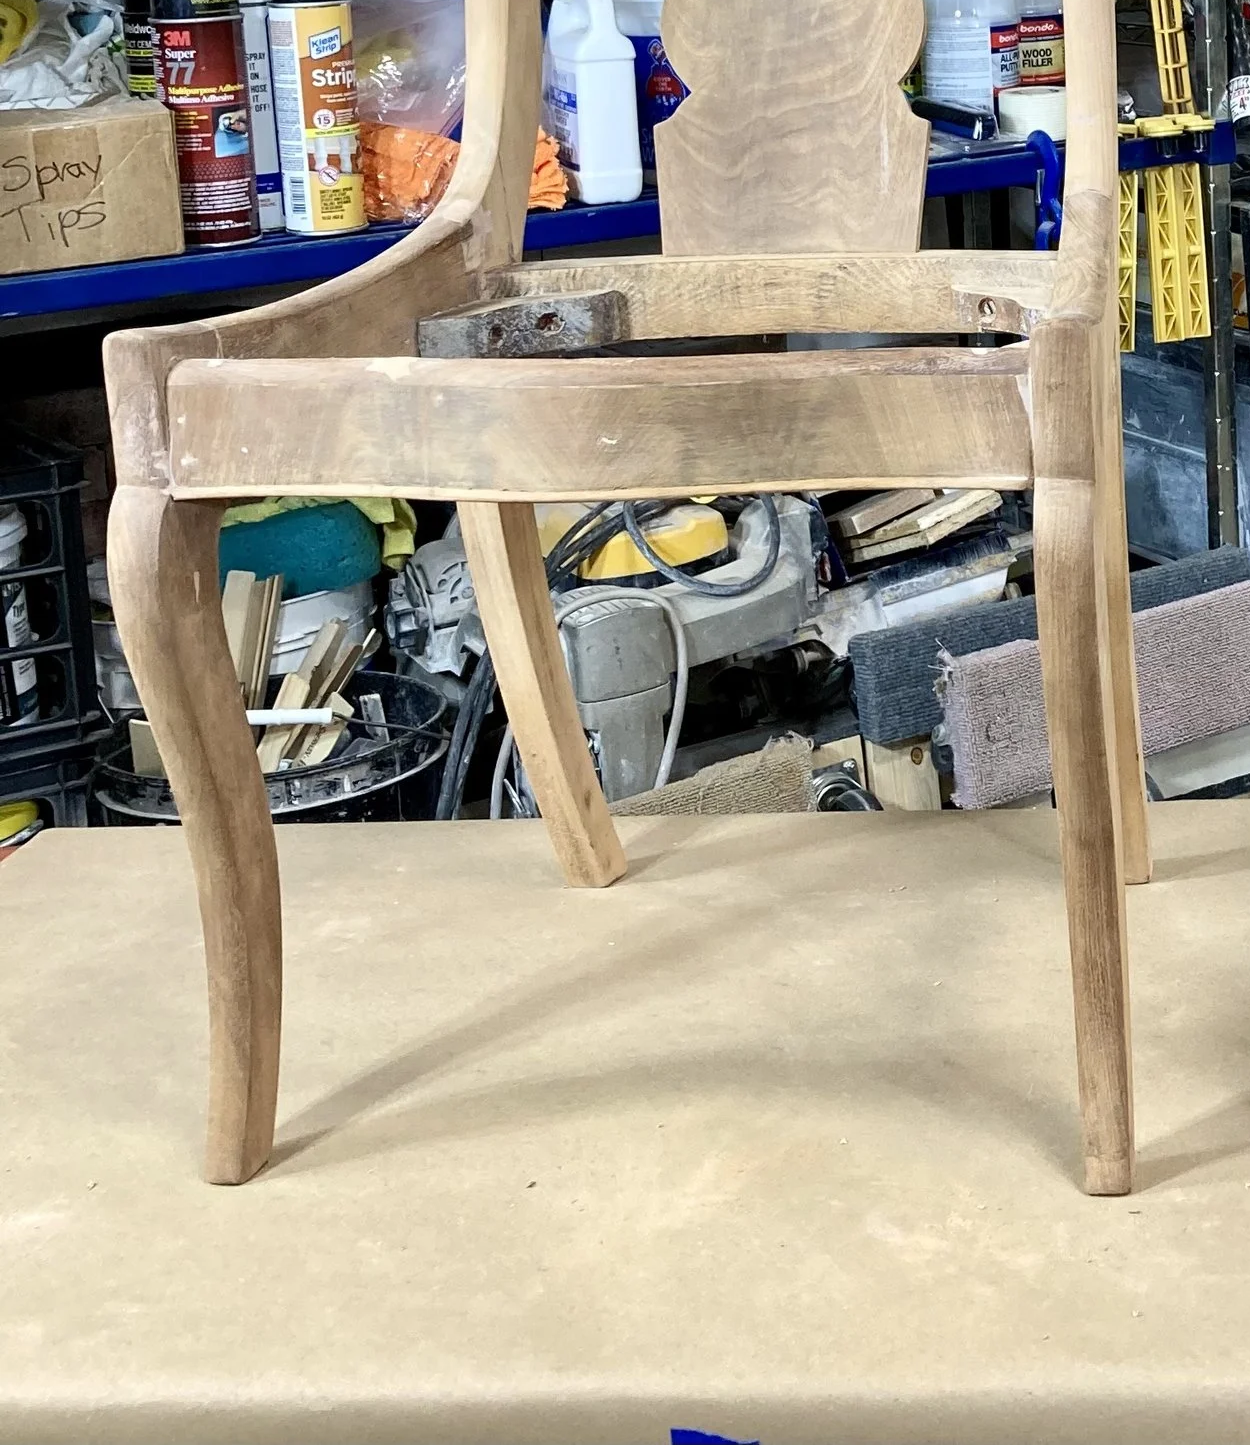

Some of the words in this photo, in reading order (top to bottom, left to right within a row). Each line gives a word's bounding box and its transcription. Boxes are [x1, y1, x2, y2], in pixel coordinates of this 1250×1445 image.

[1019, 22, 1054, 34] bondo
[163, 30, 192, 47] 3M
[164, 48, 197, 62] Super
[1022, 48, 1053, 59] WOOD
[1022, 57, 1053, 69] FILLER
[165, 61, 196, 85] 77
[250, 84, 268, 94] HOSE
[317, 113, 331, 125] 15
[2, 155, 102, 200] Spray
[0, 200, 106, 248] Tips
